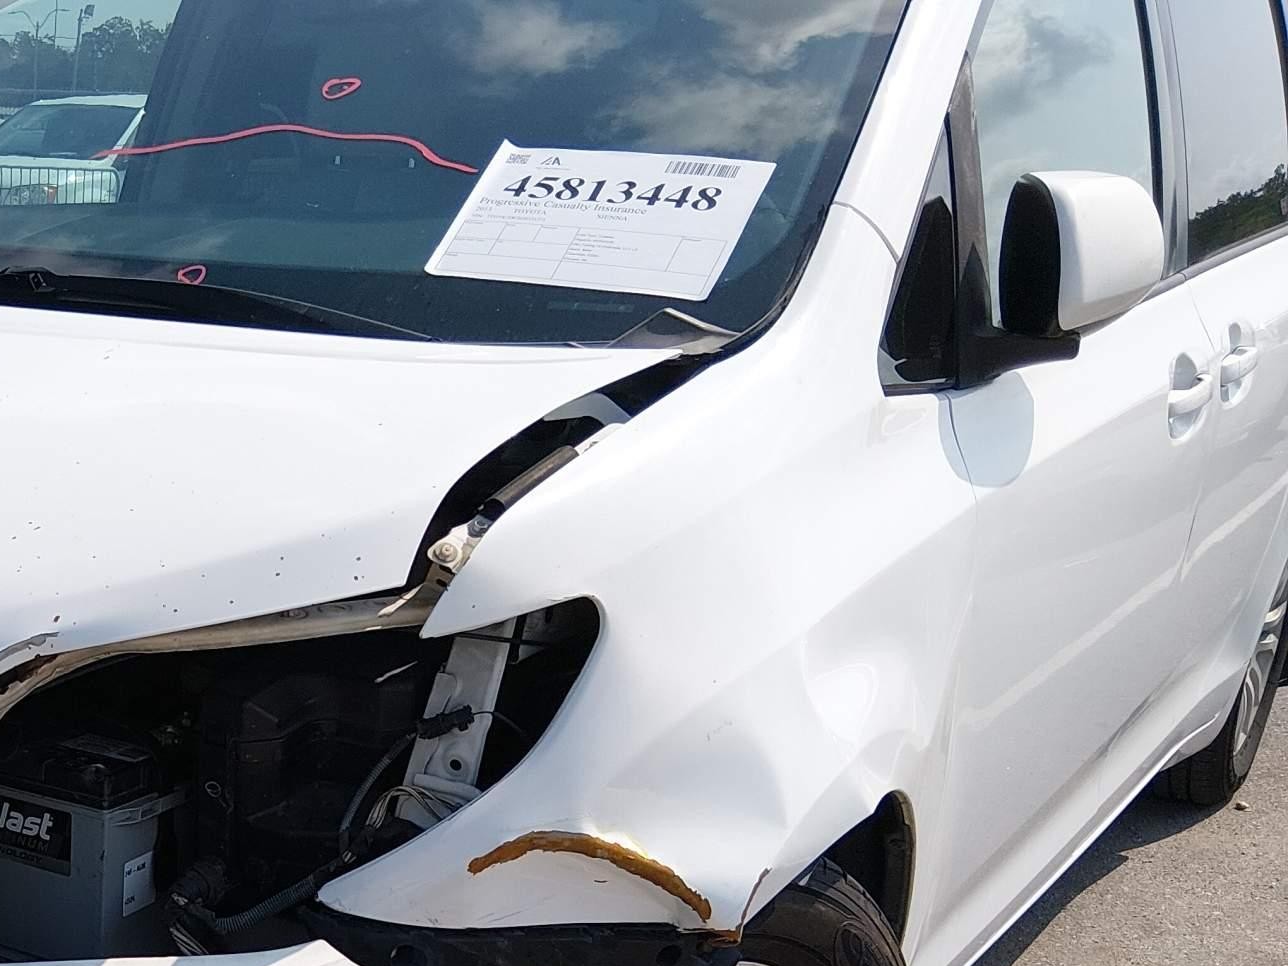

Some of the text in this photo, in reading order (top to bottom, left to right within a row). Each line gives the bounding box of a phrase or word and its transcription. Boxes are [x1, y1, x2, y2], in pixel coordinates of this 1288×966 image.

[479, 197, 648, 215] Progressive Casualty Insurance
[503, 175, 722, 211] 45813448
